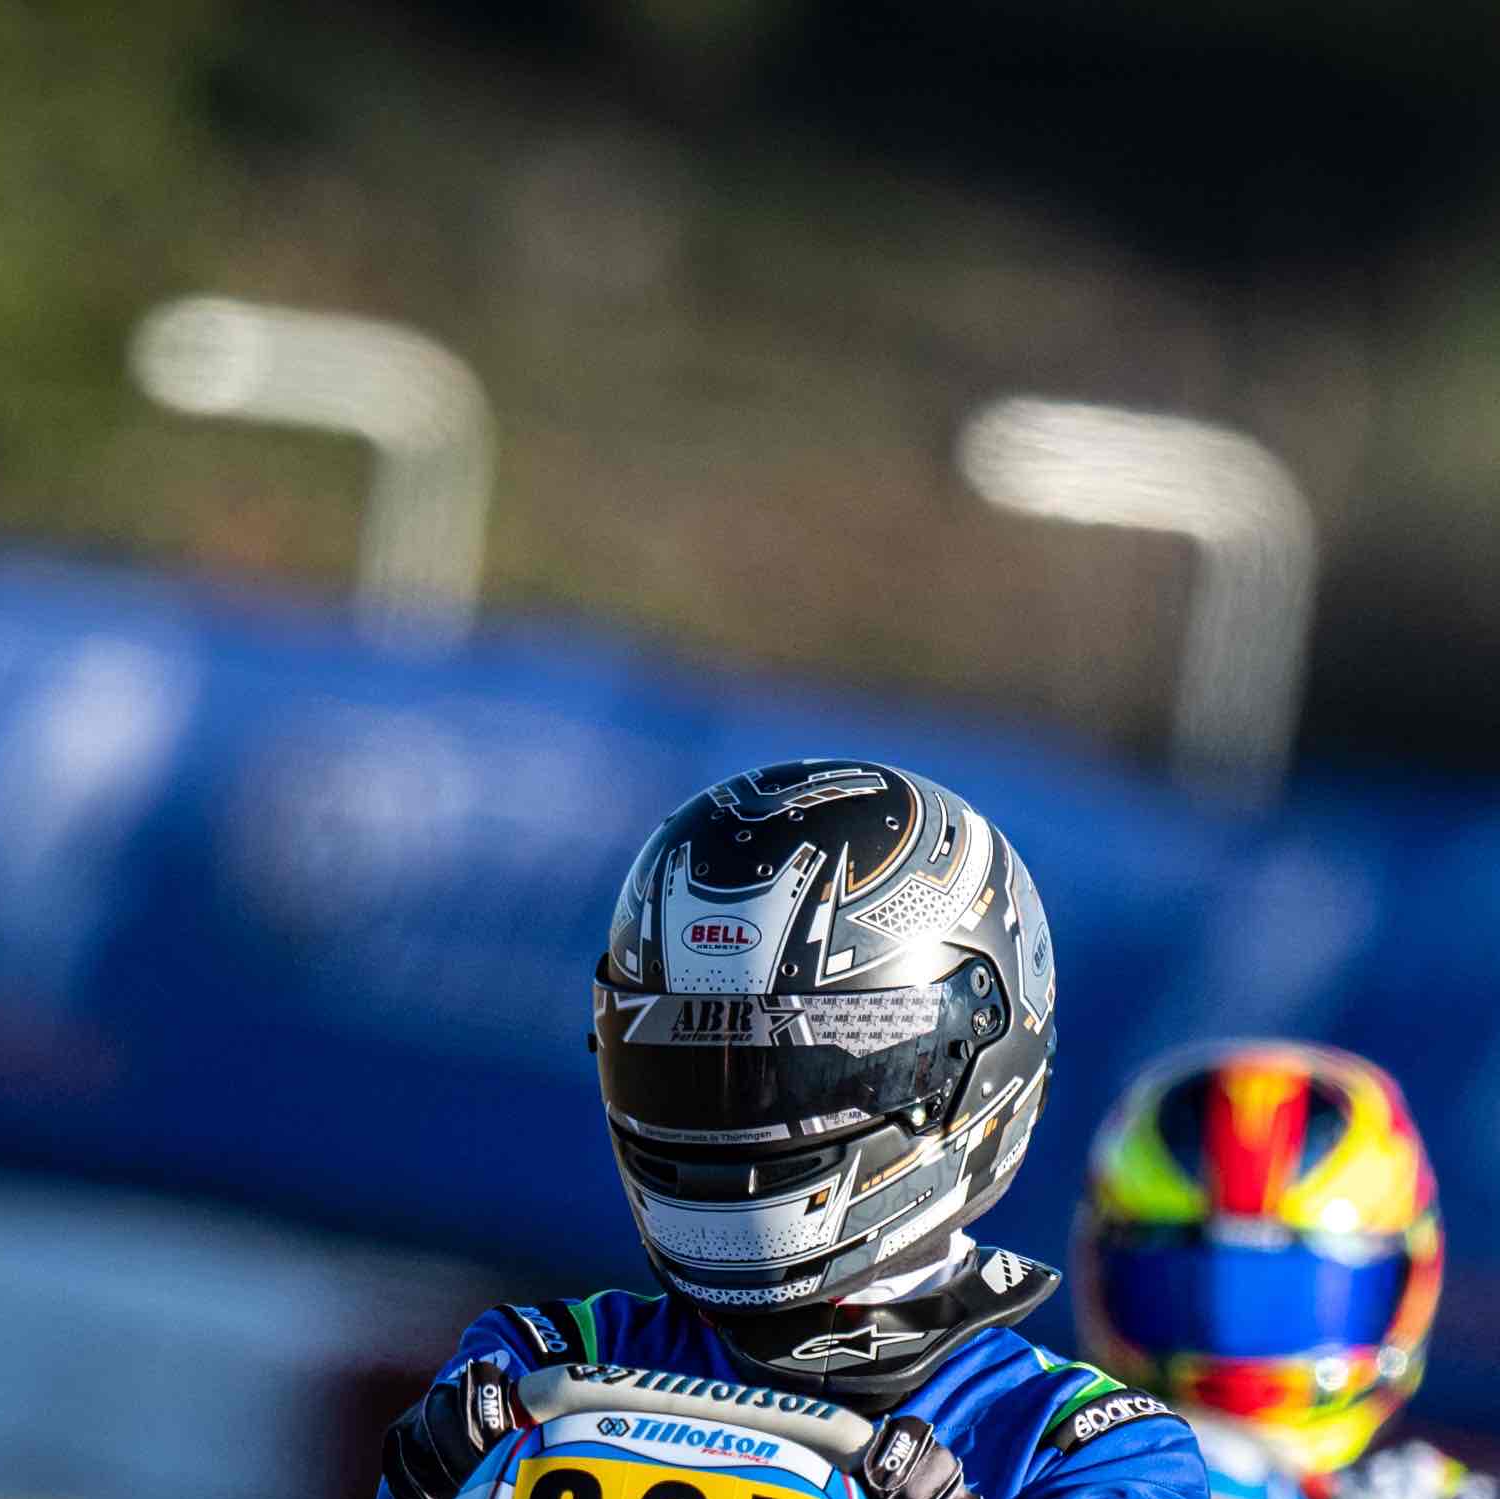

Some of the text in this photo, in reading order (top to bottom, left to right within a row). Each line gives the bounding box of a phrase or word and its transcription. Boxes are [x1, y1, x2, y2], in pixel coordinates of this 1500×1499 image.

[690, 924, 749, 944] BELL
[670, 1000, 754, 1032] ABR
[482, 1383, 500, 1430] OMP
[630, 1417, 780, 1458] Tillotson
[885, 1432, 912, 1471] OMP
